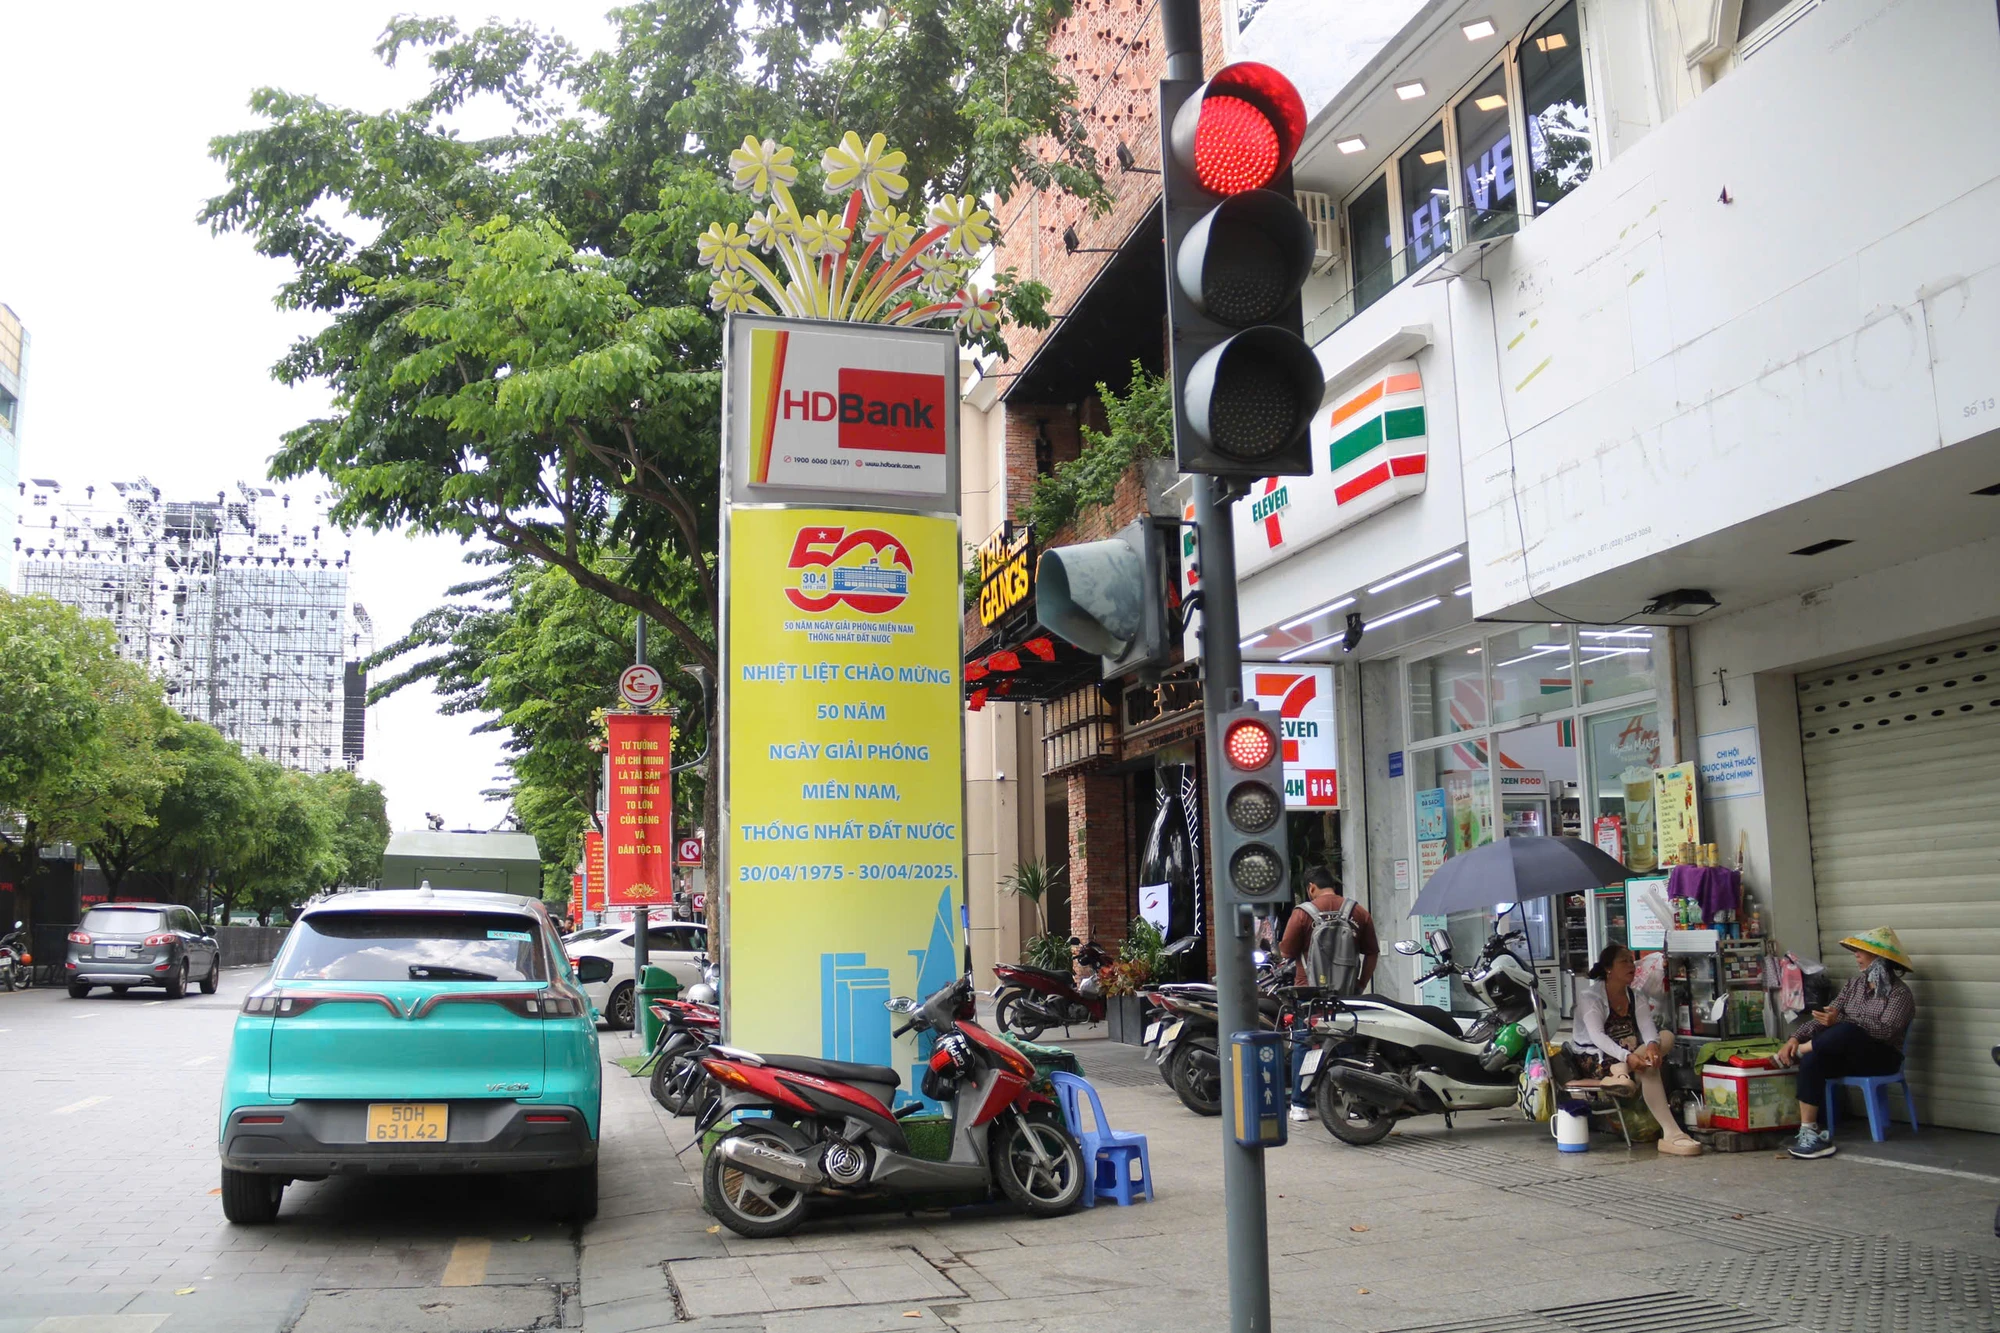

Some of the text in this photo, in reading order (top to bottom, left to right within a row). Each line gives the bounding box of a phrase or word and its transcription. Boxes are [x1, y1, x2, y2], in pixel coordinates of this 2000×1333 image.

[783, 389, 934, 429] HDBank
[1963, 397, 1995, 418] Số 13
[865, 461, 921, 470] www.hdbank.com.vn
[1252, 485, 1288, 523] ELEVEn
[802, 573, 826, 584] 30.4
[980, 550, 1028, 626] GANGS
[785, 622, 793, 630] 50
[796, 620, 812, 630] NĂM
[814, 620, 834, 630] NGÀY
[836, 620, 850, 630] GIẢI
[852, 622, 877, 631] PHÓNG
[743, 662, 950, 684] NHIỆT LIỆT CHÀO MỪNG
[817, 702, 885, 720] 50 NĂM
[621, 740, 658, 750] TƯ TƯỞNG
[770, 740, 929, 760] NGÀY GIẢI PHÓNG
[1728, 747, 1739, 757] HỘI
[615, 754, 664, 765] HỒ CHÍ MINH
[1702, 756, 1756, 772] DƯỢC NHÀ THUỐC
[618, 769, 660, 780] LÀ TÀI SẢN
[1726, 770, 1736, 780] CHÍ
[1737, 770, 1753, 778] MINH
[620, 786, 638, 794] TINH
[802, 780, 900, 801] MIỀN NAM,
[1284, 780, 1304, 796] 4H
[626, 800, 653, 809] TO LỚN
[620, 814, 659, 824] CỦA ĐẢNG
[635, 829, 645, 839] VÀ
[742, 820, 955, 840] THỐNG NHẤT ĐẤT NƯỚC
[618, 844, 662, 855] DÂN TỘC TA
[740, 865, 844, 882] 30/04/1975
[859, 865, 958, 881] 30/04/2025.
[392, 1107, 425, 1121] 50H
[376, 1124, 438, 1139] 631.42
